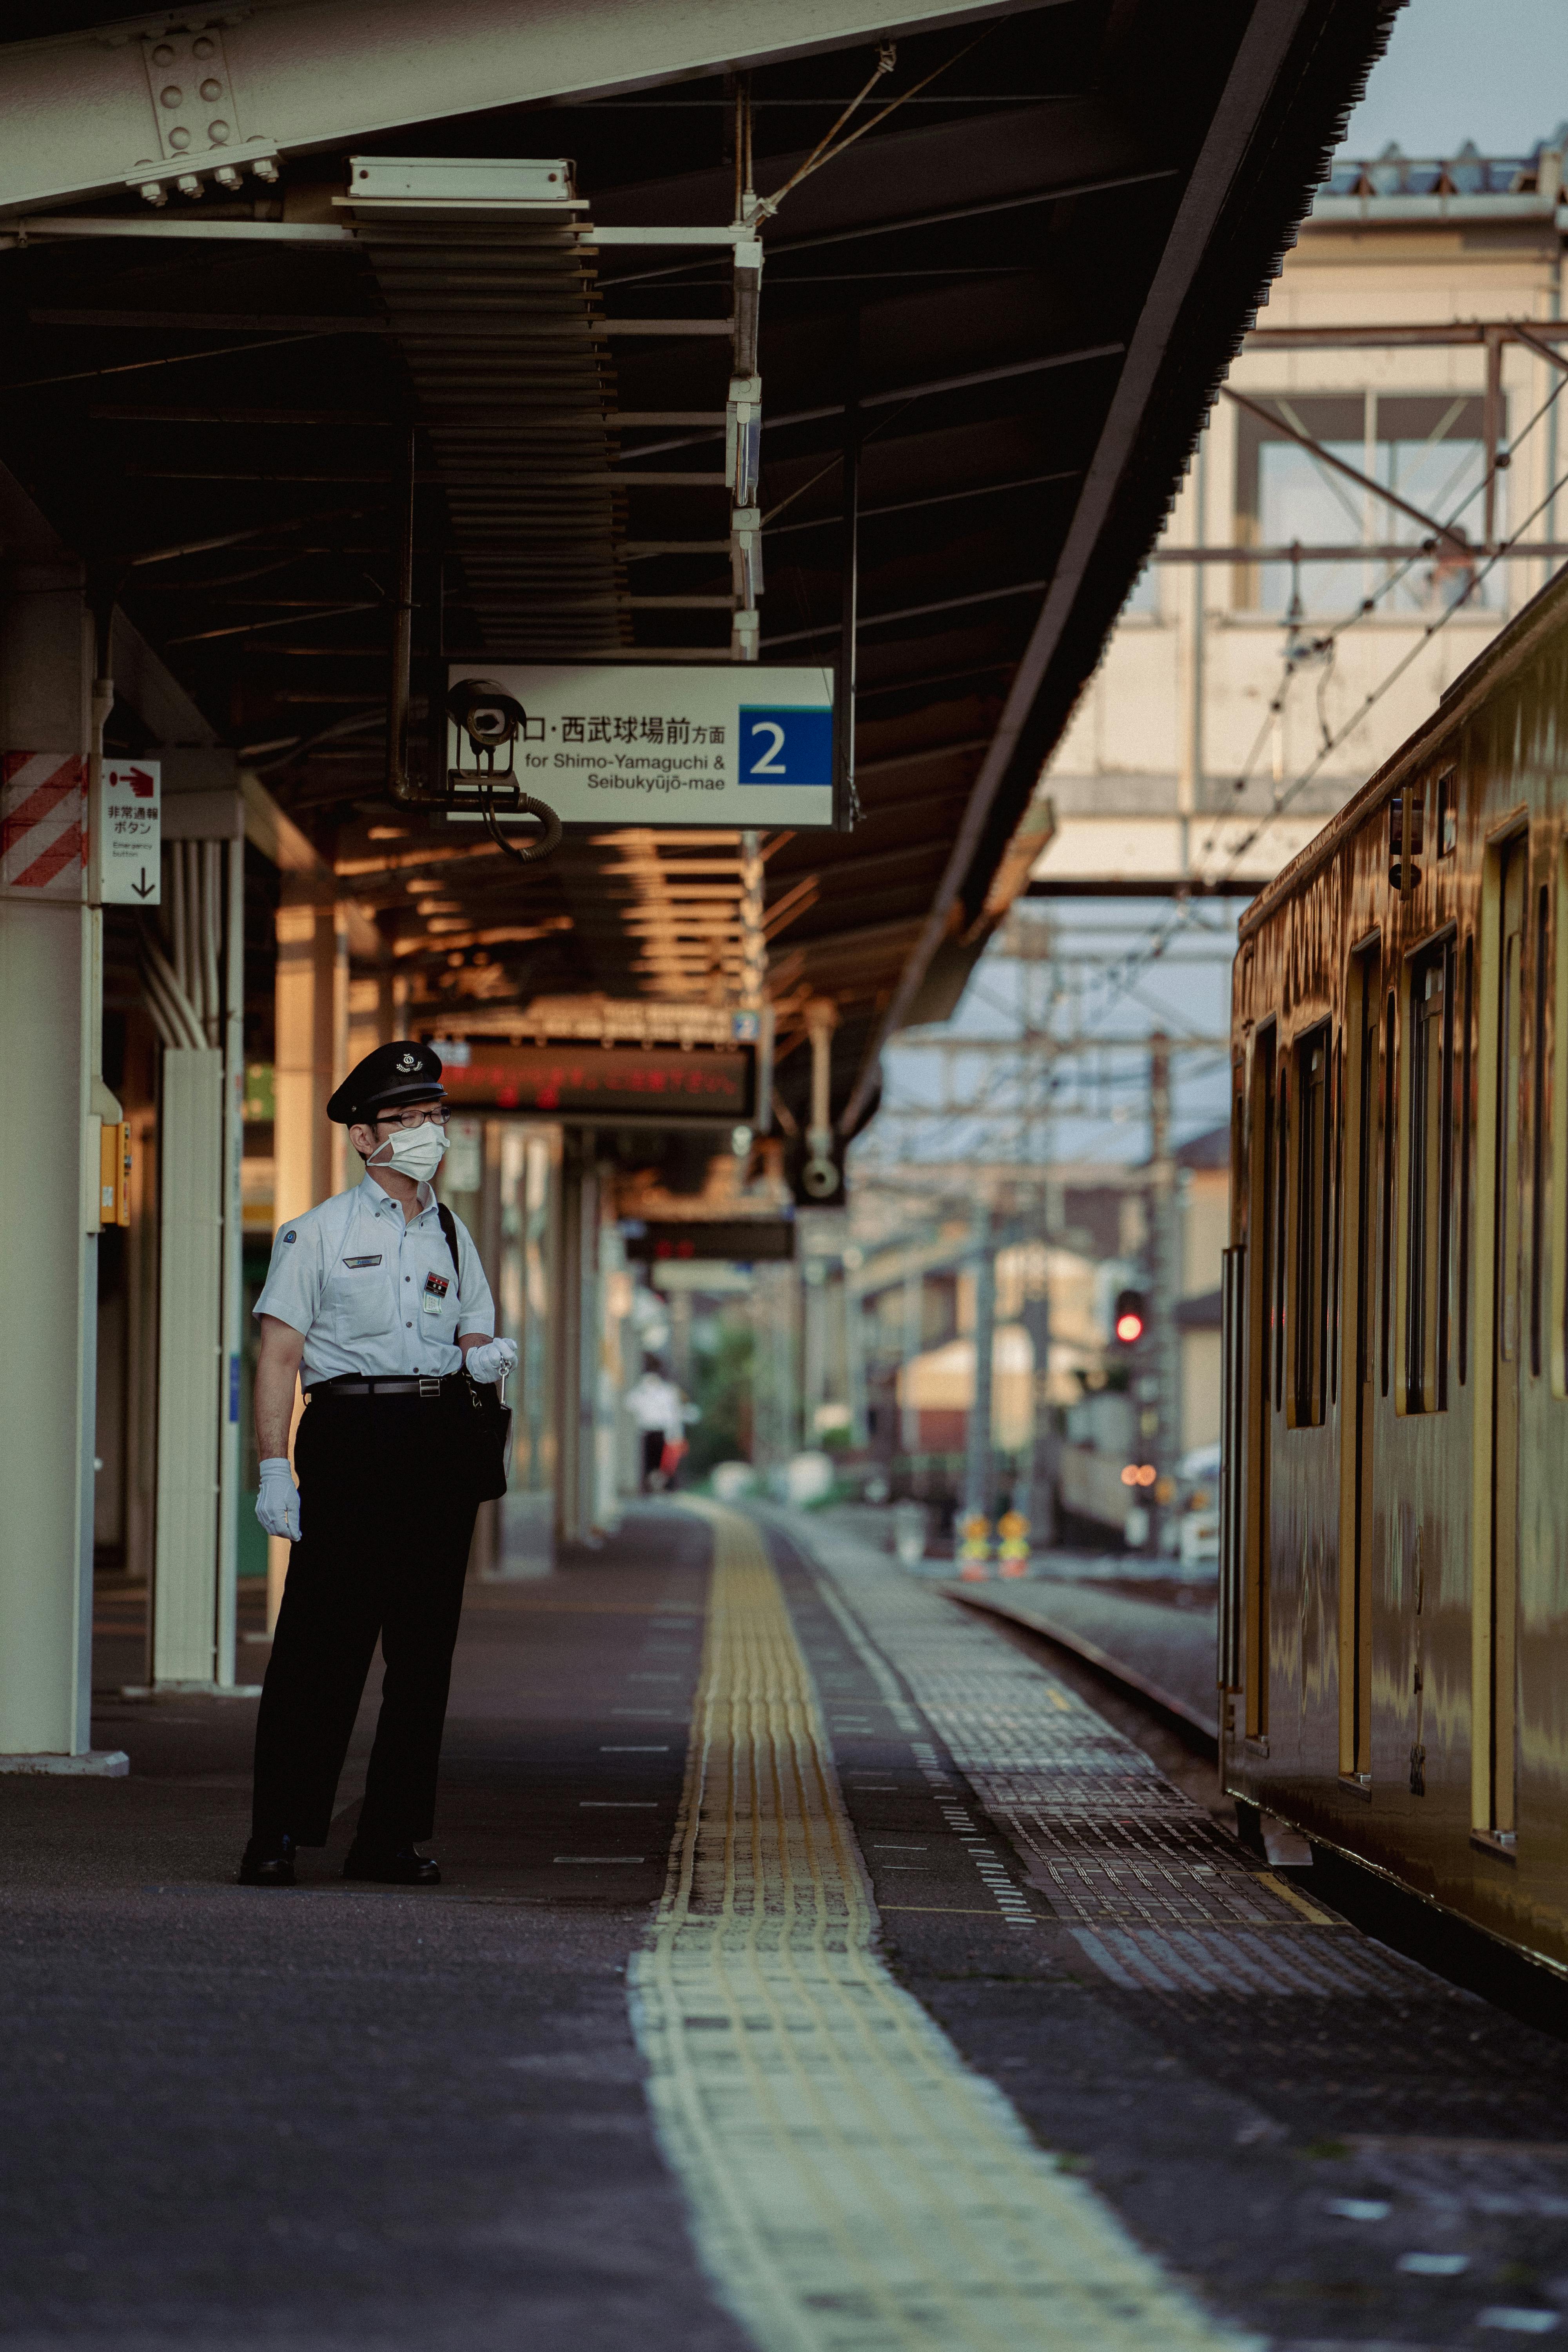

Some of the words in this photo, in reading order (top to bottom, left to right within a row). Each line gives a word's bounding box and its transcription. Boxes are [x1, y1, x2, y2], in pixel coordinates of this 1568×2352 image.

[514, 716, 725, 744] 口・西武球場前方面
[750, 722, 786, 774] 2
[525, 753, 548, 768] for
[554, 753, 708, 772] Shimo-Yamaguchi
[713, 755, 725, 770] &
[588, 774, 725, 793] Seibukyūjō-mae
[108, 806, 158, 820] 非常通報
[114, 821, 151, 834] ボタン
[113, 842, 152, 850] Emergency
